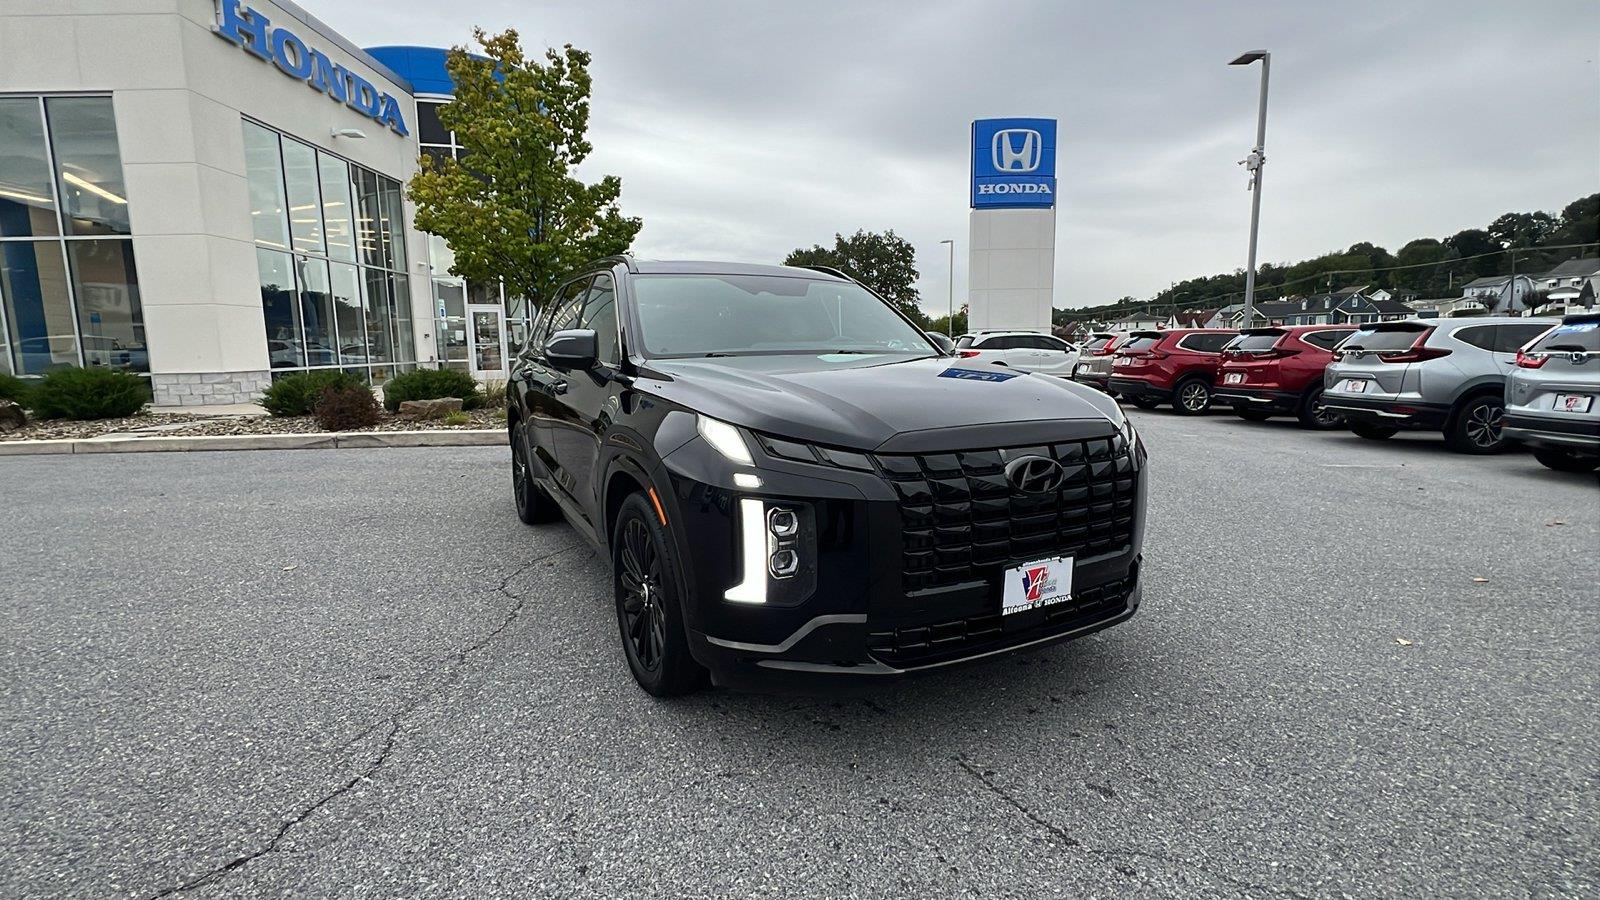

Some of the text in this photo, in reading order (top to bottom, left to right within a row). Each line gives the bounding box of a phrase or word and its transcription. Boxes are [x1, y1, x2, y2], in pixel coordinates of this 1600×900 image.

[211, 0, 409, 137] HONDA
[978, 183, 1052, 195] HONDA
[1043, 594, 1073, 606] HONDA
